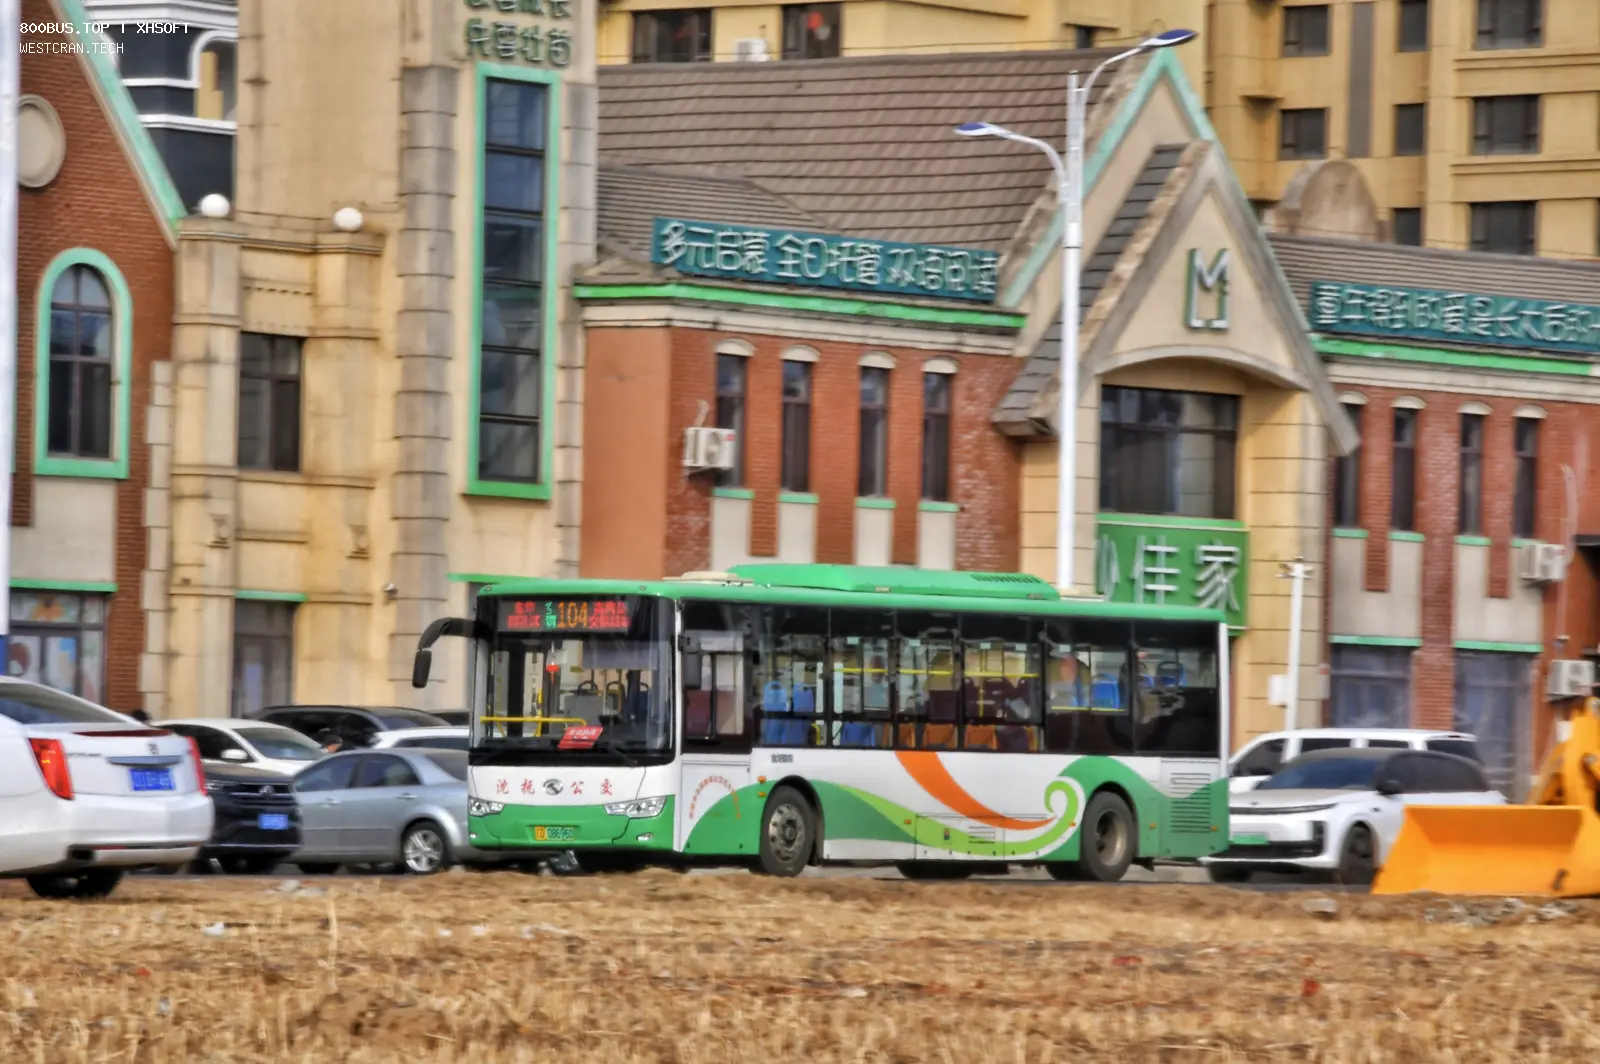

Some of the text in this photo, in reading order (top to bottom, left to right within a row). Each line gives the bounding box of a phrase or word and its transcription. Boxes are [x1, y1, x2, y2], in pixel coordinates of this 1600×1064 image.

[660, 221, 770, 274] 多元启蒙
[774, 233, 884, 286] 全日托管
[557, 601, 588, 629] 104
